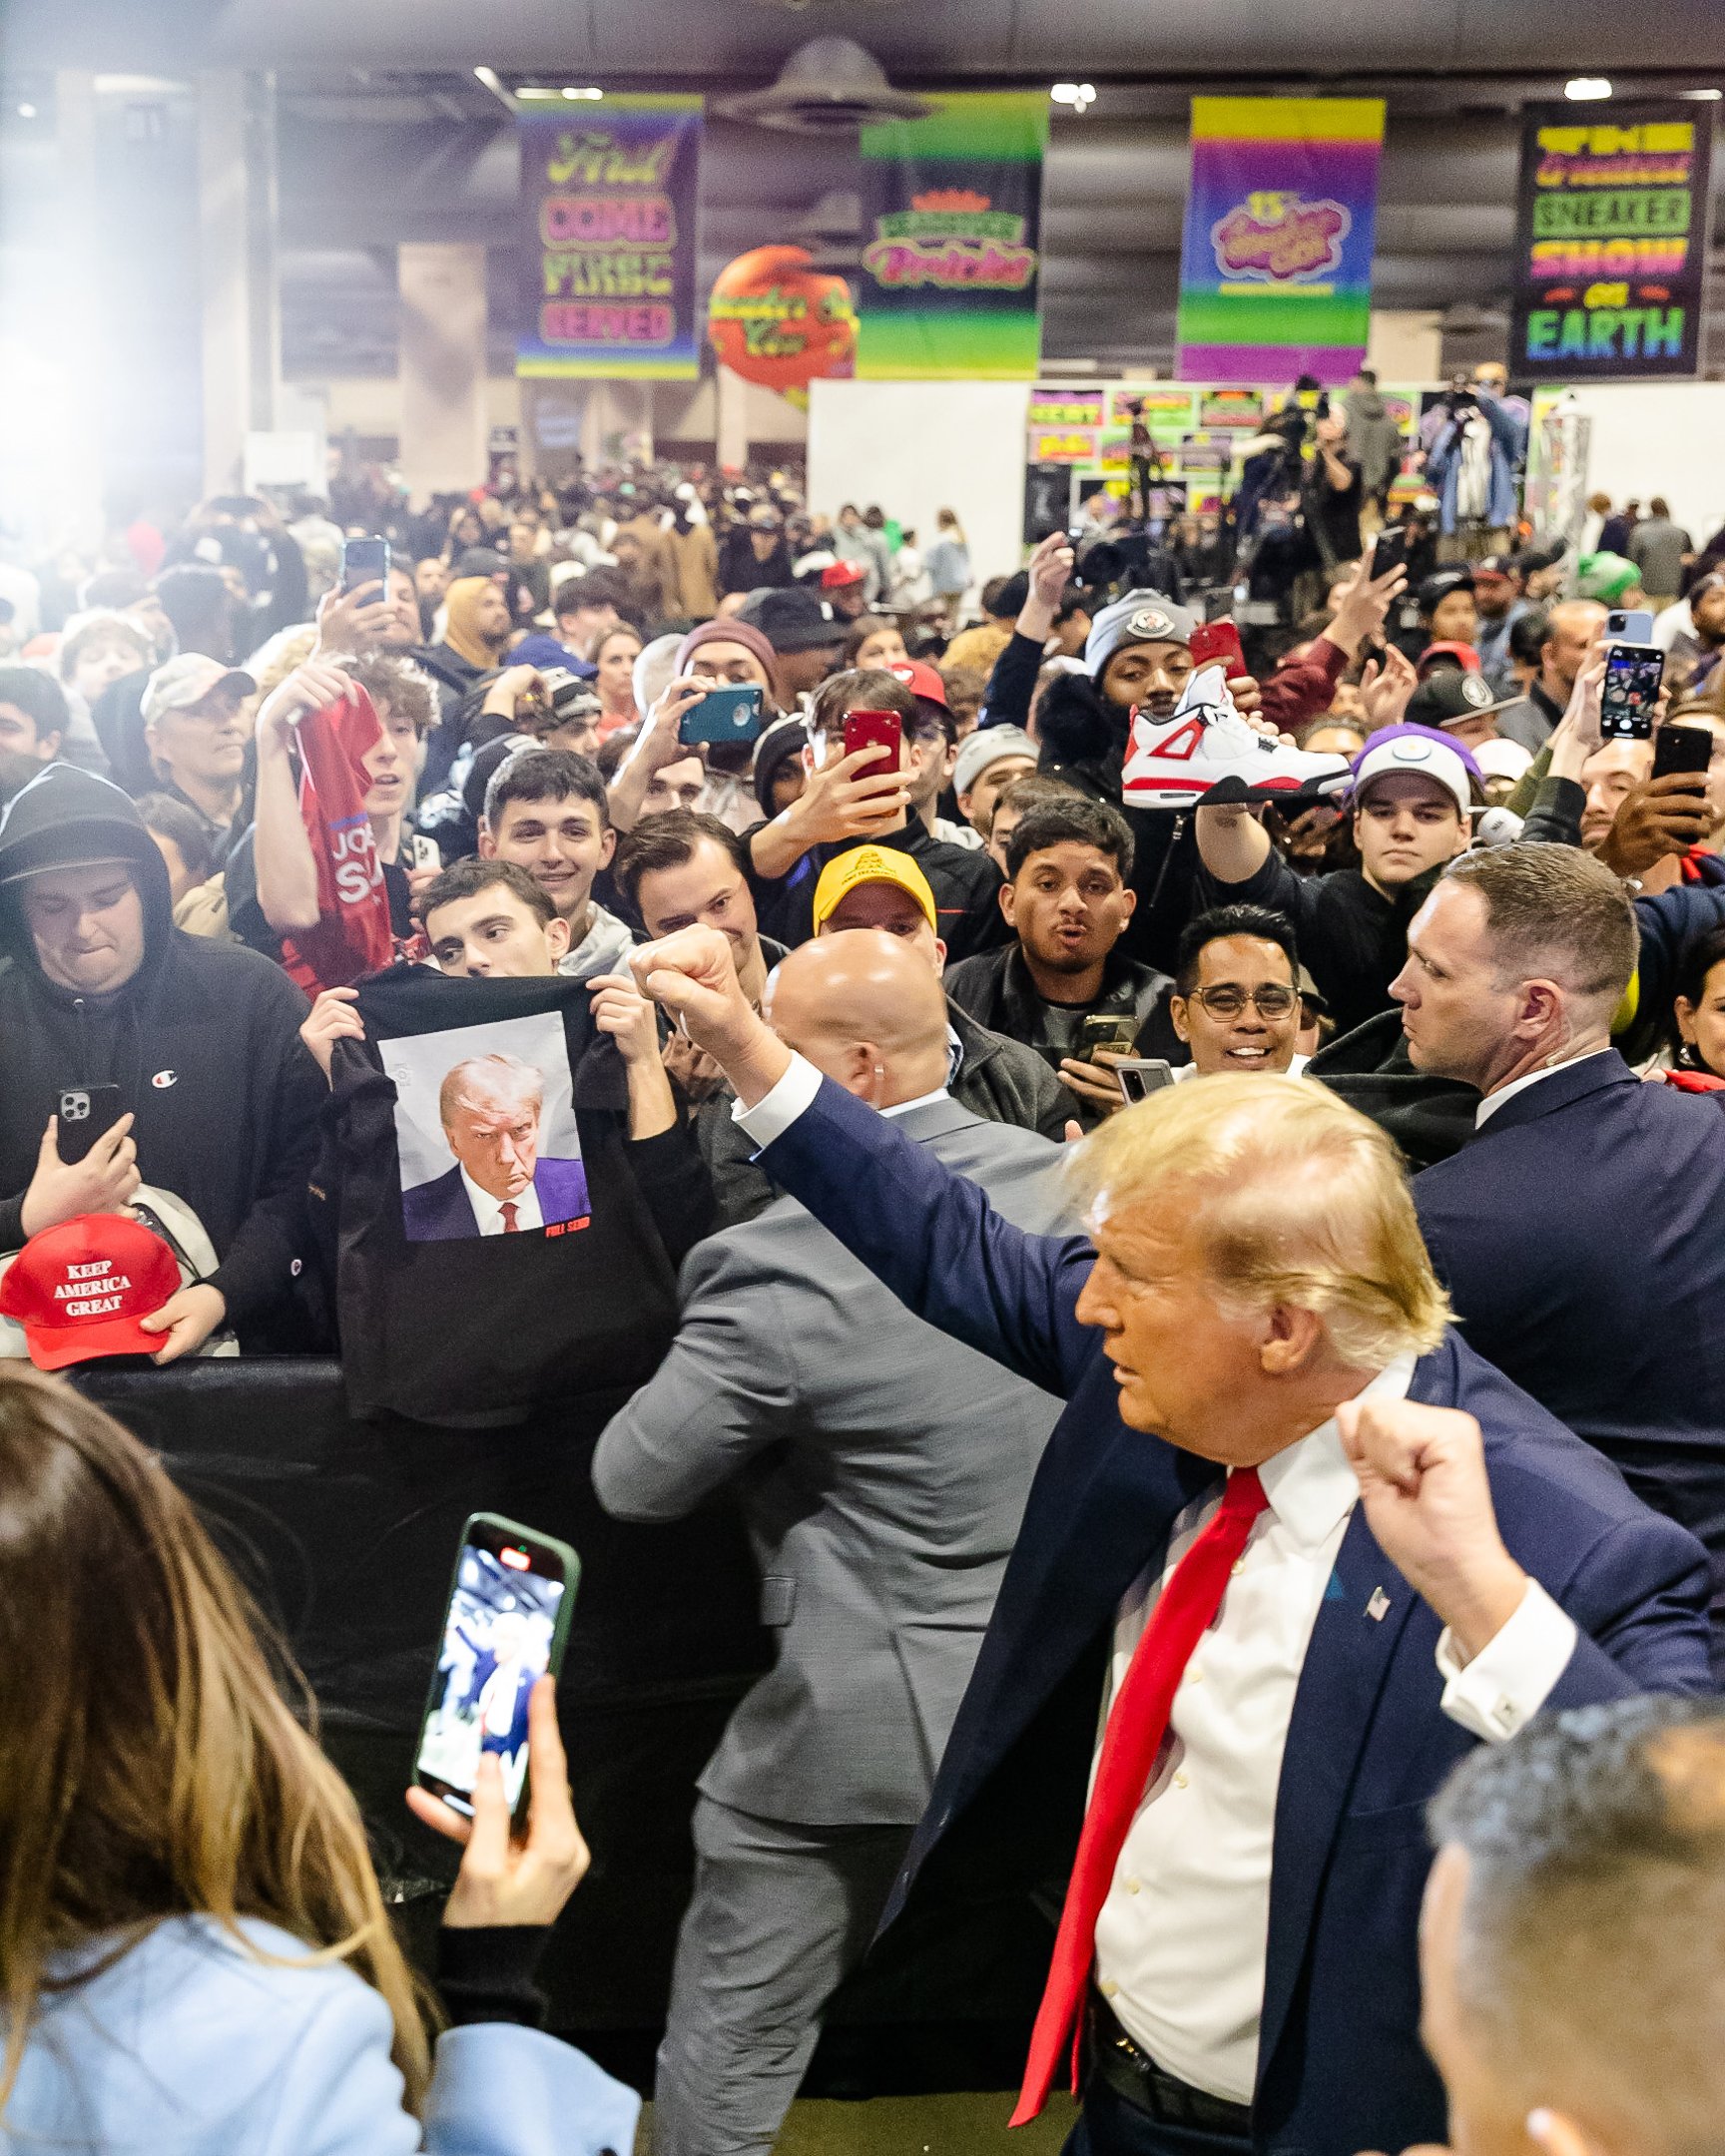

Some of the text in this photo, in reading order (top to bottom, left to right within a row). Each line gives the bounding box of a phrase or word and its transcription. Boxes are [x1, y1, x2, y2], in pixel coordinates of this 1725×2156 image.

[1533, 190, 1691, 238] SNEAKER
[1531, 239, 1688, 277] SHOW
[1526, 307, 1685, 360] EARTH
[67, 1260, 113, 1280] KEEP
[54, 1276, 132, 1299] AMERICA
[66, 1296, 123, 1317] GREAT
